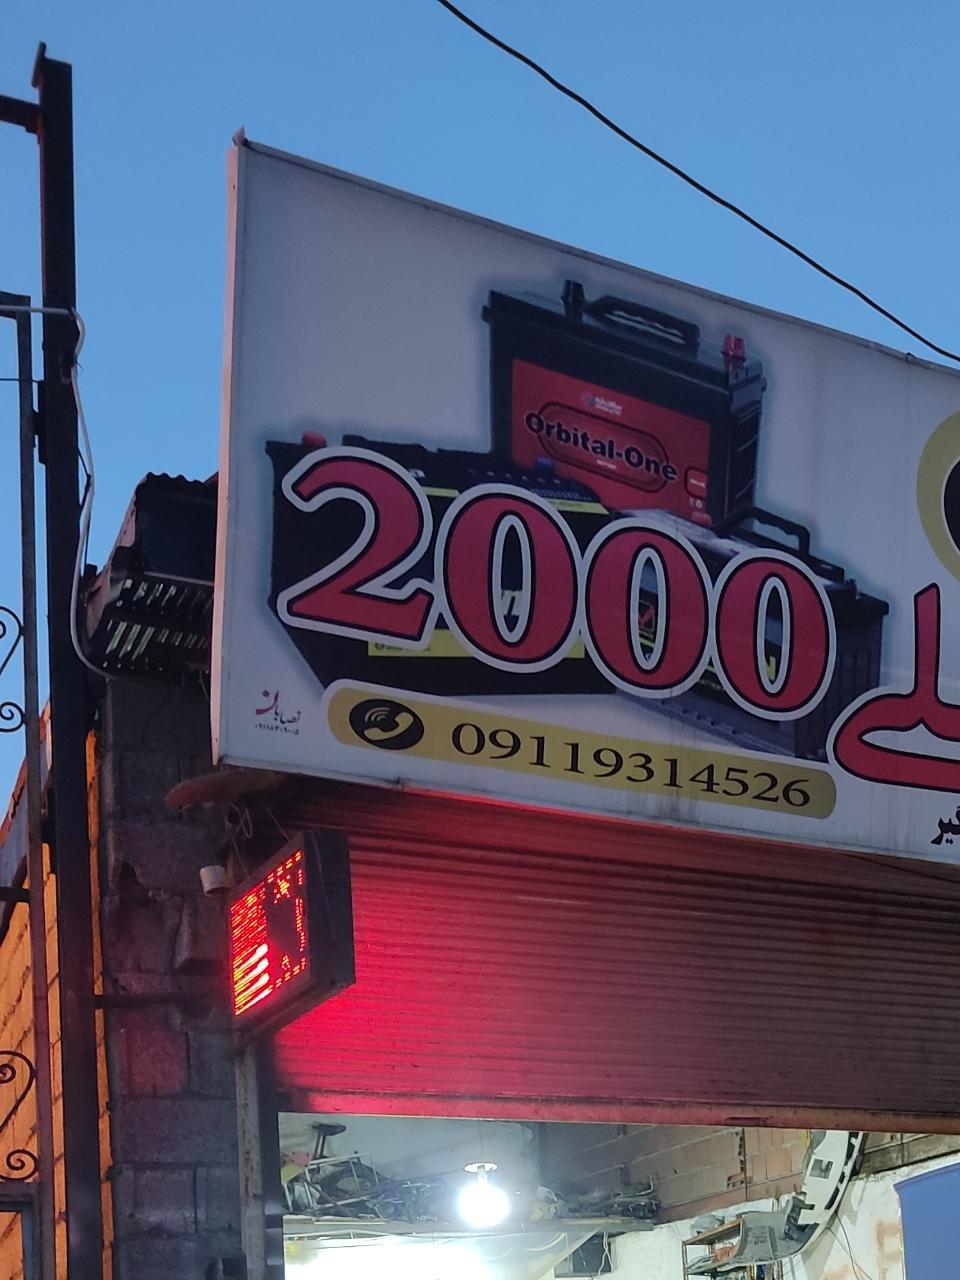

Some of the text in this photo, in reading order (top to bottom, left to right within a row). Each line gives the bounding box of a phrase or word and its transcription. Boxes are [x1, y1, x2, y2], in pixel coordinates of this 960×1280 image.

[525, 413, 678, 481] Orbital-One
[282, 450, 833, 717] 2000
[451, 721, 812, 808] 09119314526
